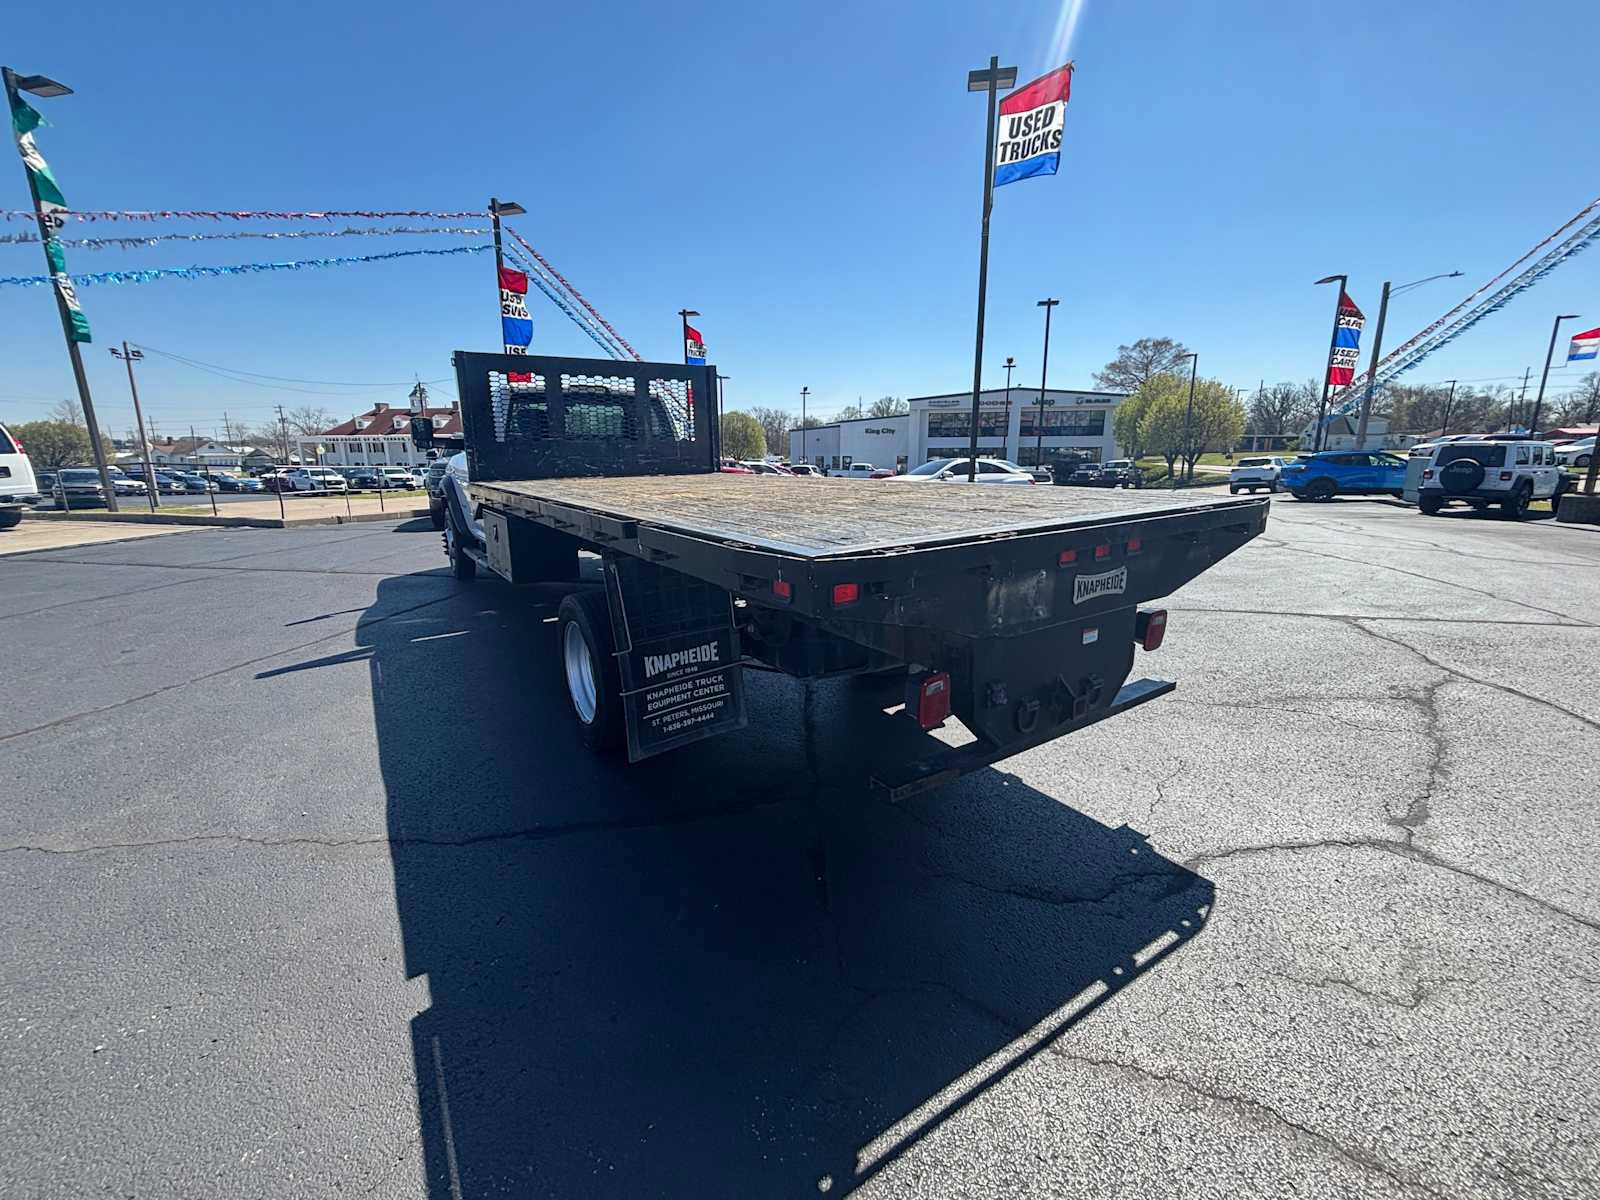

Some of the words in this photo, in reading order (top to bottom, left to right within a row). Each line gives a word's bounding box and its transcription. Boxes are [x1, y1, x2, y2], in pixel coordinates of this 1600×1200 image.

[1008, 105, 1056, 139] USED
[999, 129, 1062, 163] TRUCKS
[1333, 348, 1359, 358] USED
[1077, 571, 1126, 598] KNAPHEIDE
[644, 641, 719, 678] KNAPHEIDE
[646, 681, 693, 701] KNAPHEIDE
[695, 674, 724, 687] TRUCK
[647, 691, 691, 711] EQUIPMENT
[693, 684, 725, 697] CENTER
[691, 700, 724, 714] MISSOURI
